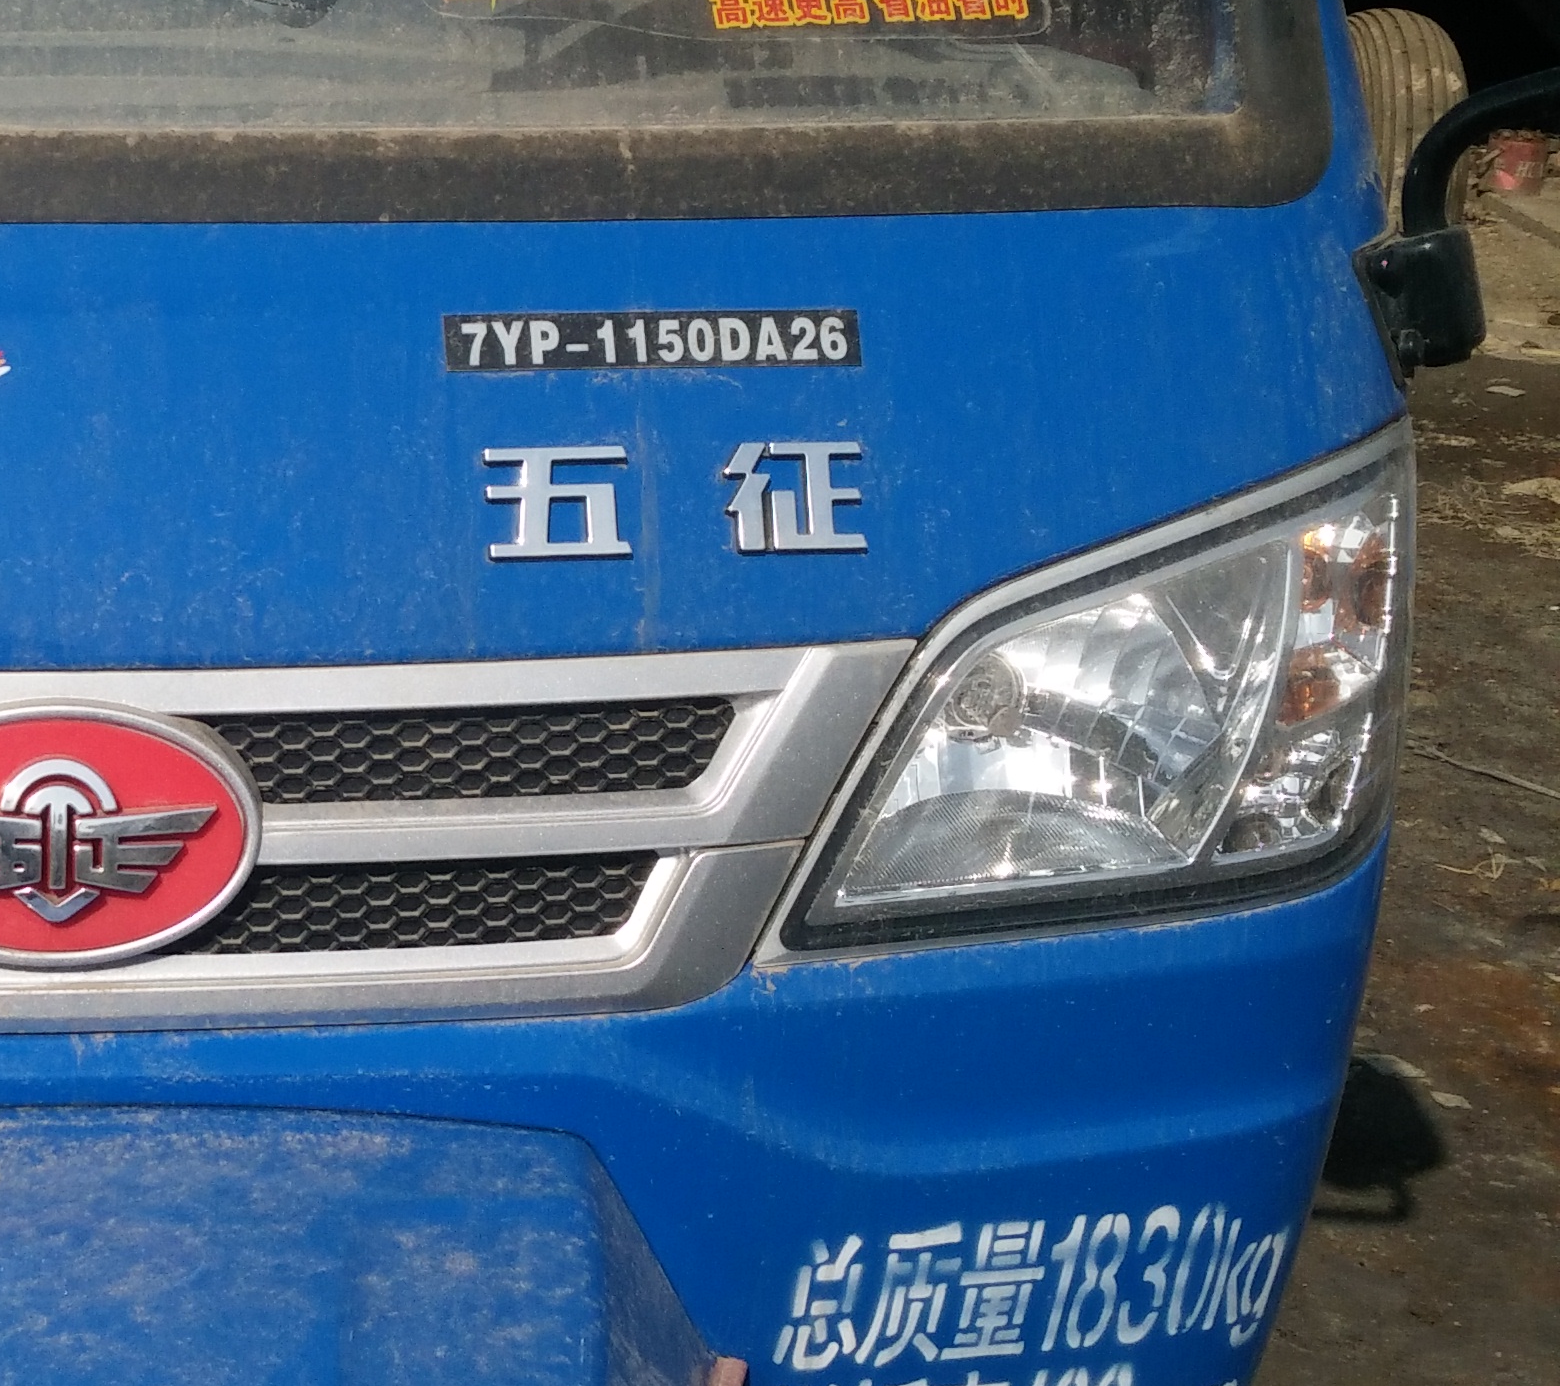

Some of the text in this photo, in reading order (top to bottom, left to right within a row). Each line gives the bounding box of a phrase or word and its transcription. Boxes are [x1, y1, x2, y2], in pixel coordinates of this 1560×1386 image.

[460, 316, 849, 367] 7YP-1150DA26
[481, 440, 869, 563] 五征
[772, 1202, 1290, 1371] 总质量1830kg
